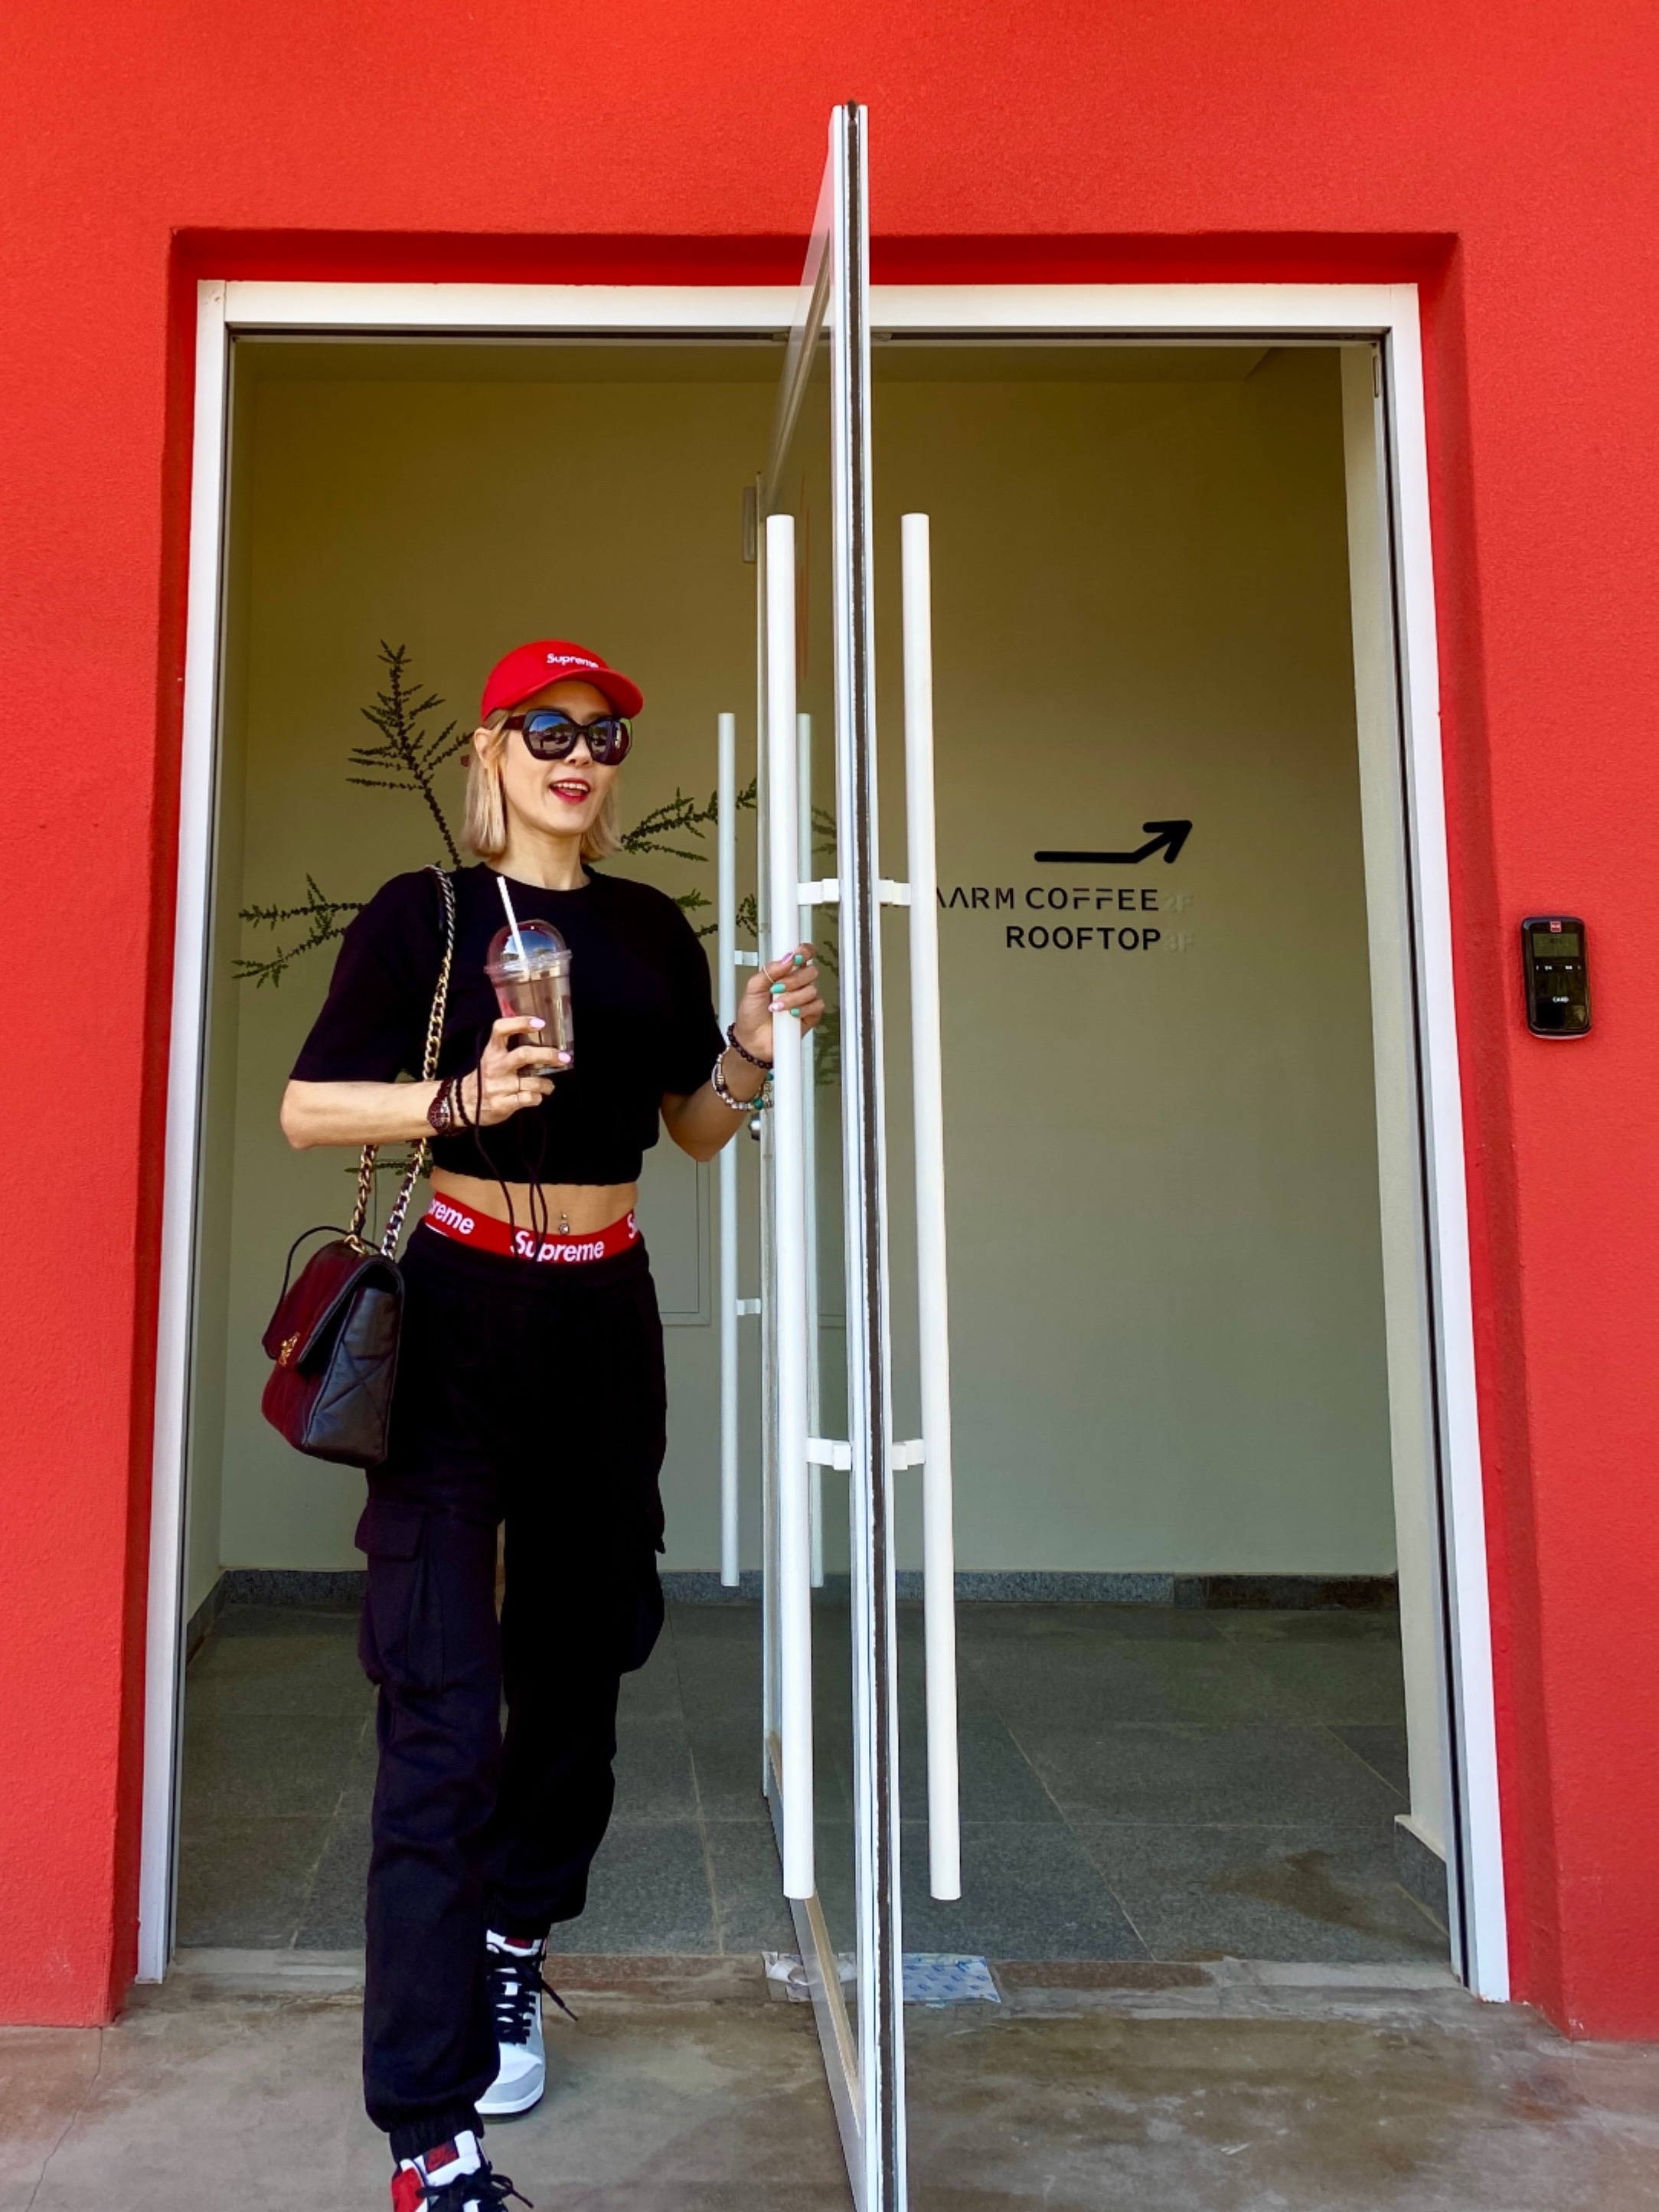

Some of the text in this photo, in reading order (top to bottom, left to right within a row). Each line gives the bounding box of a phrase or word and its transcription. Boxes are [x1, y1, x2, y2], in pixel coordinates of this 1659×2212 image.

[546, 653, 599, 668] Supreme
[1025, 887, 1159, 911] COFFEE
[1006, 926, 1161, 950] ROOFTOP
[509, 1230, 605, 1262] Supreme
